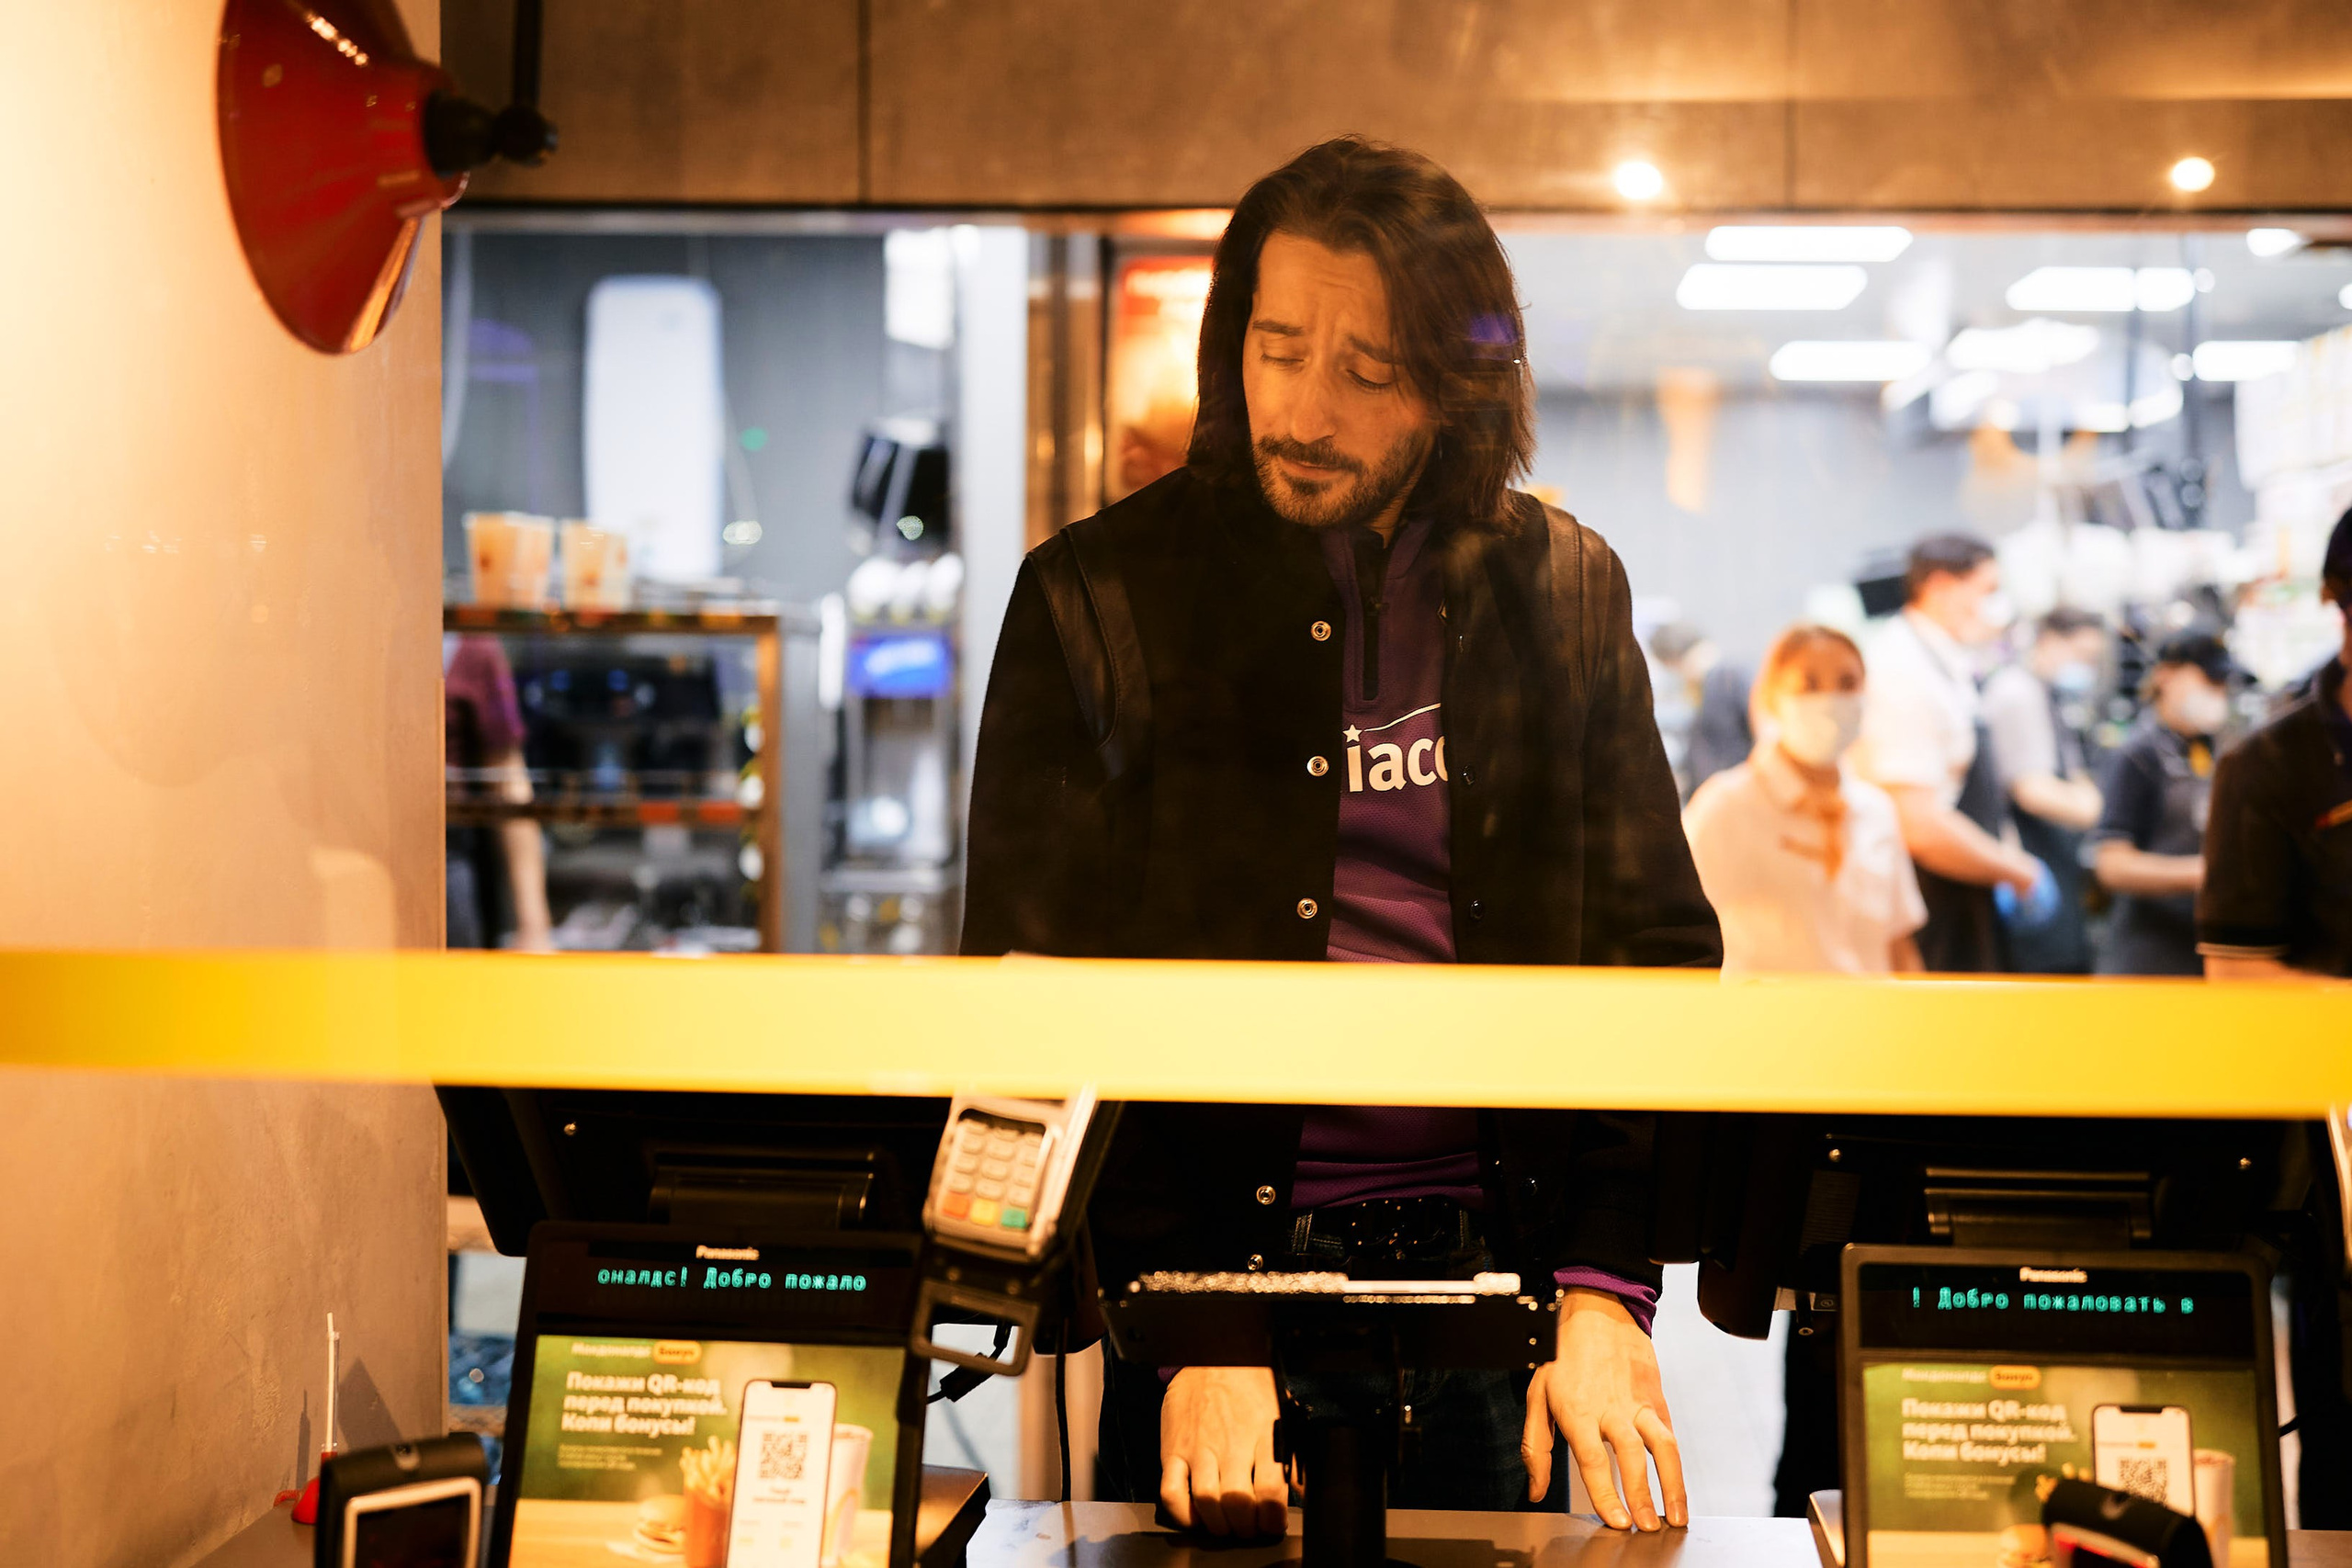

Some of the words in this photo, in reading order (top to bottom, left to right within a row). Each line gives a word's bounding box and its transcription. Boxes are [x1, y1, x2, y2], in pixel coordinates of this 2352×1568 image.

[597, 1266, 688, 1288] оналдс!
[703, 1267, 772, 1289] Добро
[785, 1273, 866, 1291] пожало
[2019, 1267, 2088, 1283] Panasonic
[1938, 1287, 2009, 1311] Добро
[2023, 1293, 2166, 1314] пожаловать
[566, 1371, 646, 1393] Покажи
[646, 1373, 721, 1396] QR-код
[563, 1395, 626, 1415] перед
[1902, 1398, 1987, 1419] Покажи
[1987, 1399, 2066, 1422] QR-код
[561, 1412, 613, 1432] Копи
[614, 1413, 696, 1438] бонусы!
[1902, 1423, 1969, 1443] перед
[1903, 1440, 1959, 1460] Копи
[1959, 1441, 2047, 1466] бонусы!
